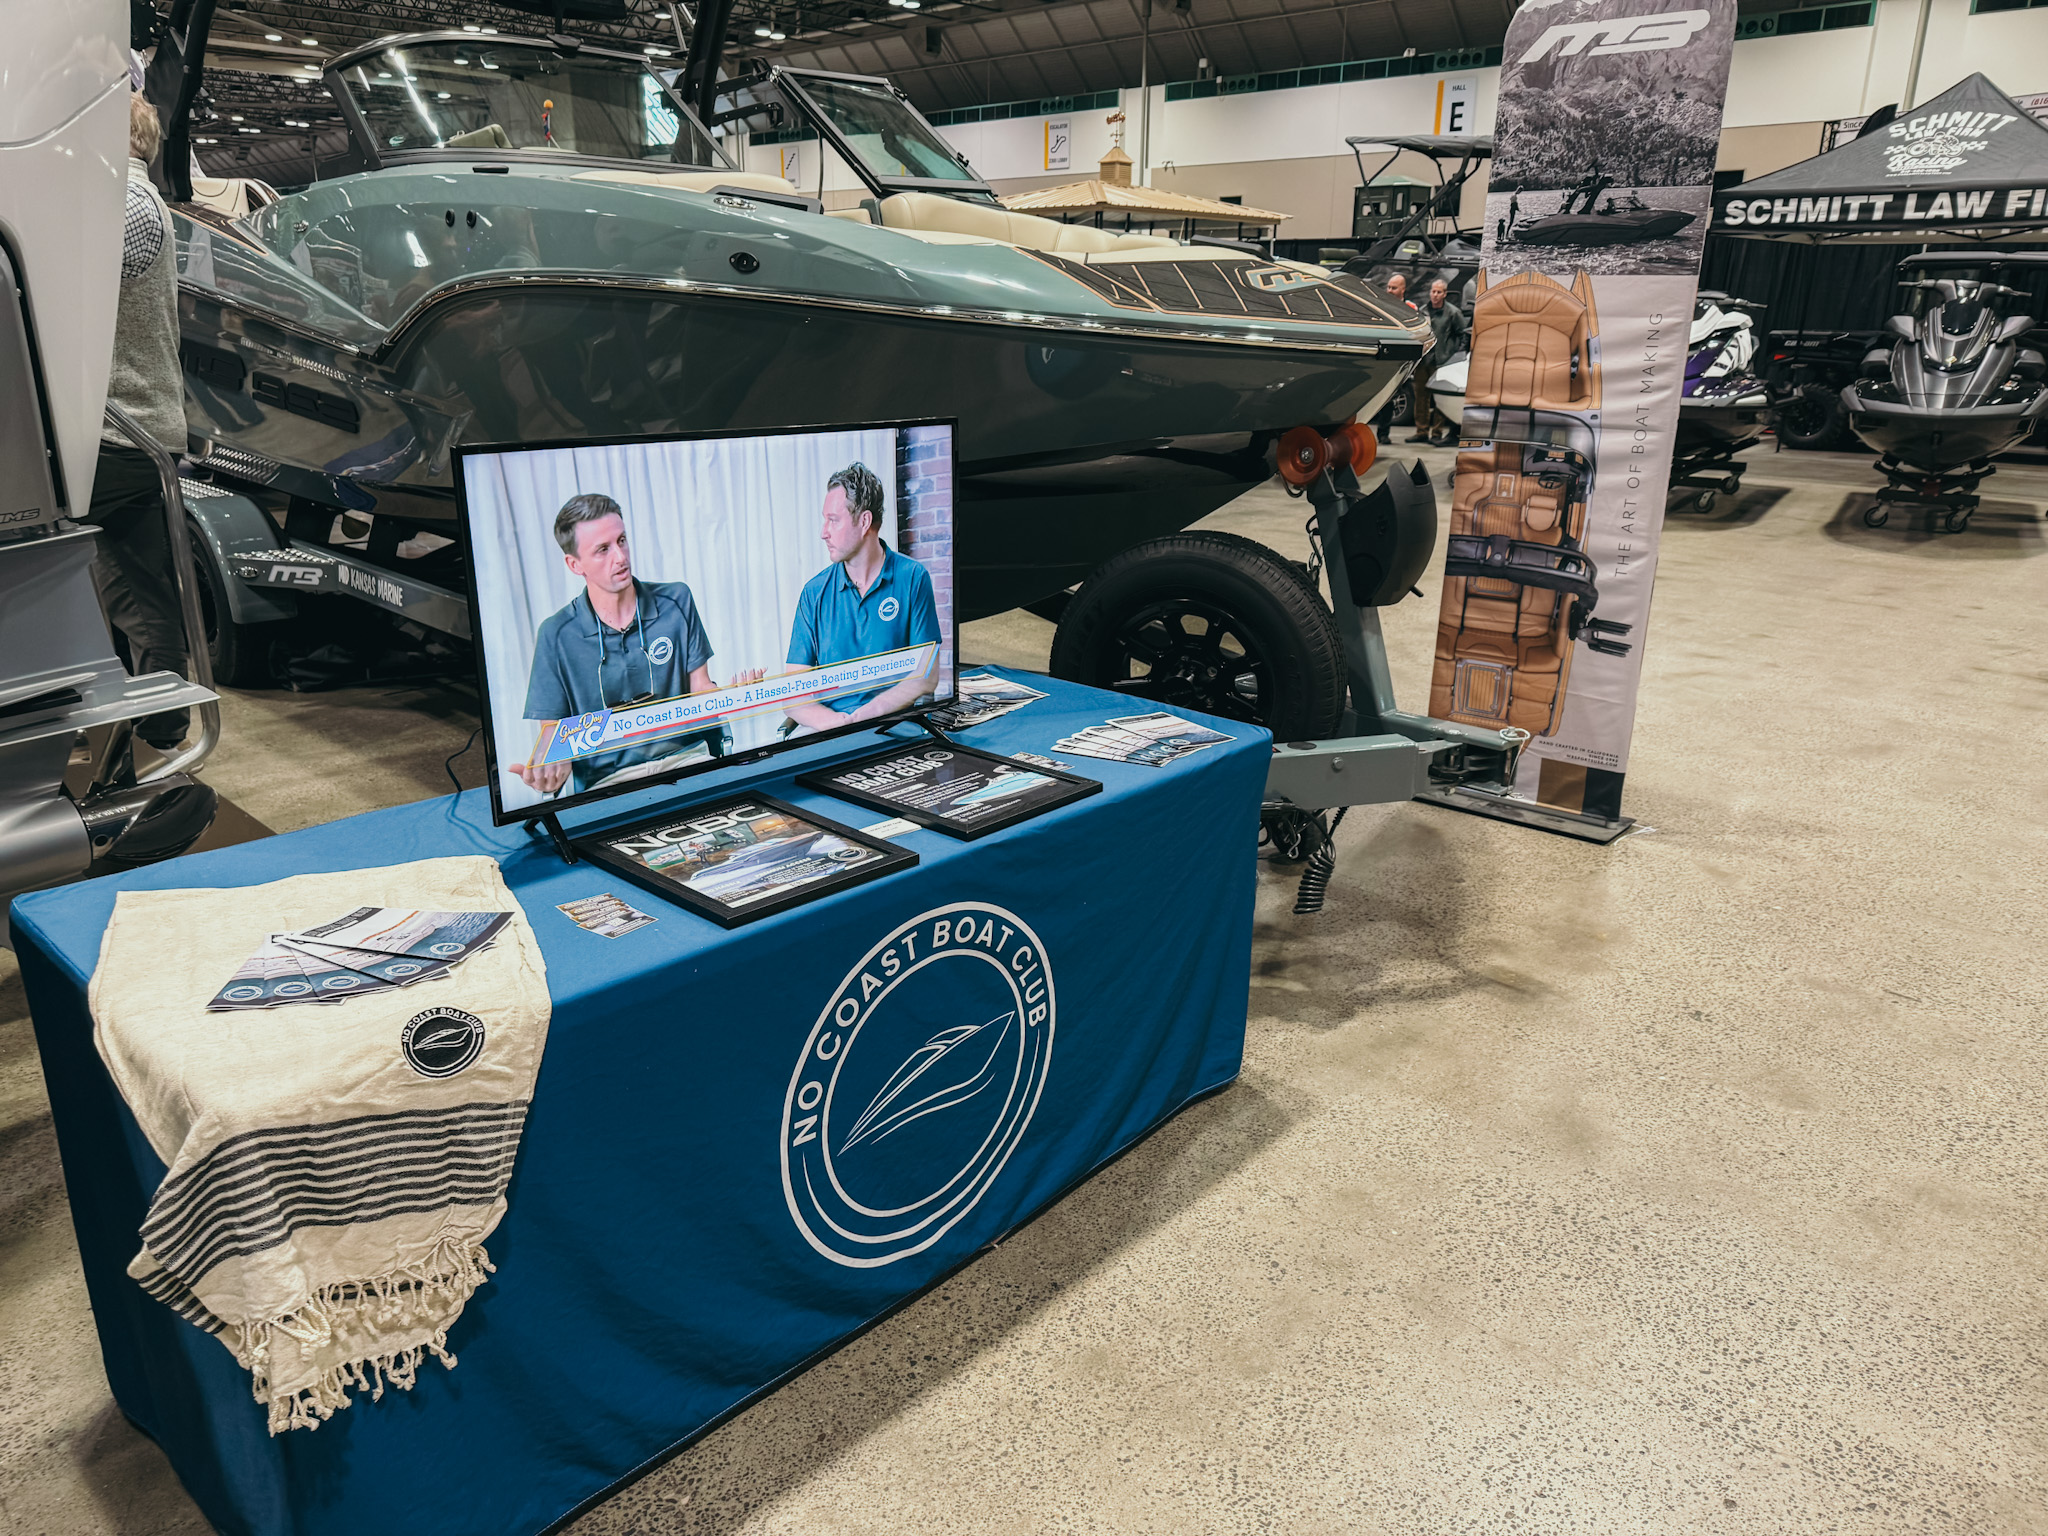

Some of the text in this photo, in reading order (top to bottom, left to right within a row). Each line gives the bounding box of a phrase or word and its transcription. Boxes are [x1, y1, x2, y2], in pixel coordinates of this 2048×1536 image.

[1449, 101, 1465, 132] E
[1889, 111, 2018, 138] SCHMITT
[1904, 126, 1986, 141] LAW FIRM
[1886, 151, 1968, 171] Racing
[1724, 188, 2048, 226] SCHMITT LAW FI
[1614, 312, 1663, 577] THE ART OF BOAT MAKING
[267, 565, 323, 585] MB
[338, 564, 404, 607] MID KANSAS MARINE
[613, 718, 632, 732] No
[636, 711, 673, 727] Coast
[675, 704, 702, 719] Boat
[704, 697, 734, 711] Club
[744, 691, 754, 703] A
[755, 676, 819, 700] Hassel-Free
[821, 668, 860, 689] Boating
[861, 656, 916, 678] Experience
[560, 711, 603, 744] Great Day
[568, 725, 605, 756] KC
[1587, 748, 1619, 758] CALIFORNIA
[832, 773, 867, 785] NO
[862, 755, 925, 776] COAST
[849, 773, 901, 791] BOAT
[896, 760, 944, 776] CLUB
[611, 805, 773, 856] NCBC
[402, 1007, 484, 1043] NO COAST BOAT CLUB
[793, 916, 1047, 1147] NO COAST BOAT CLUB
